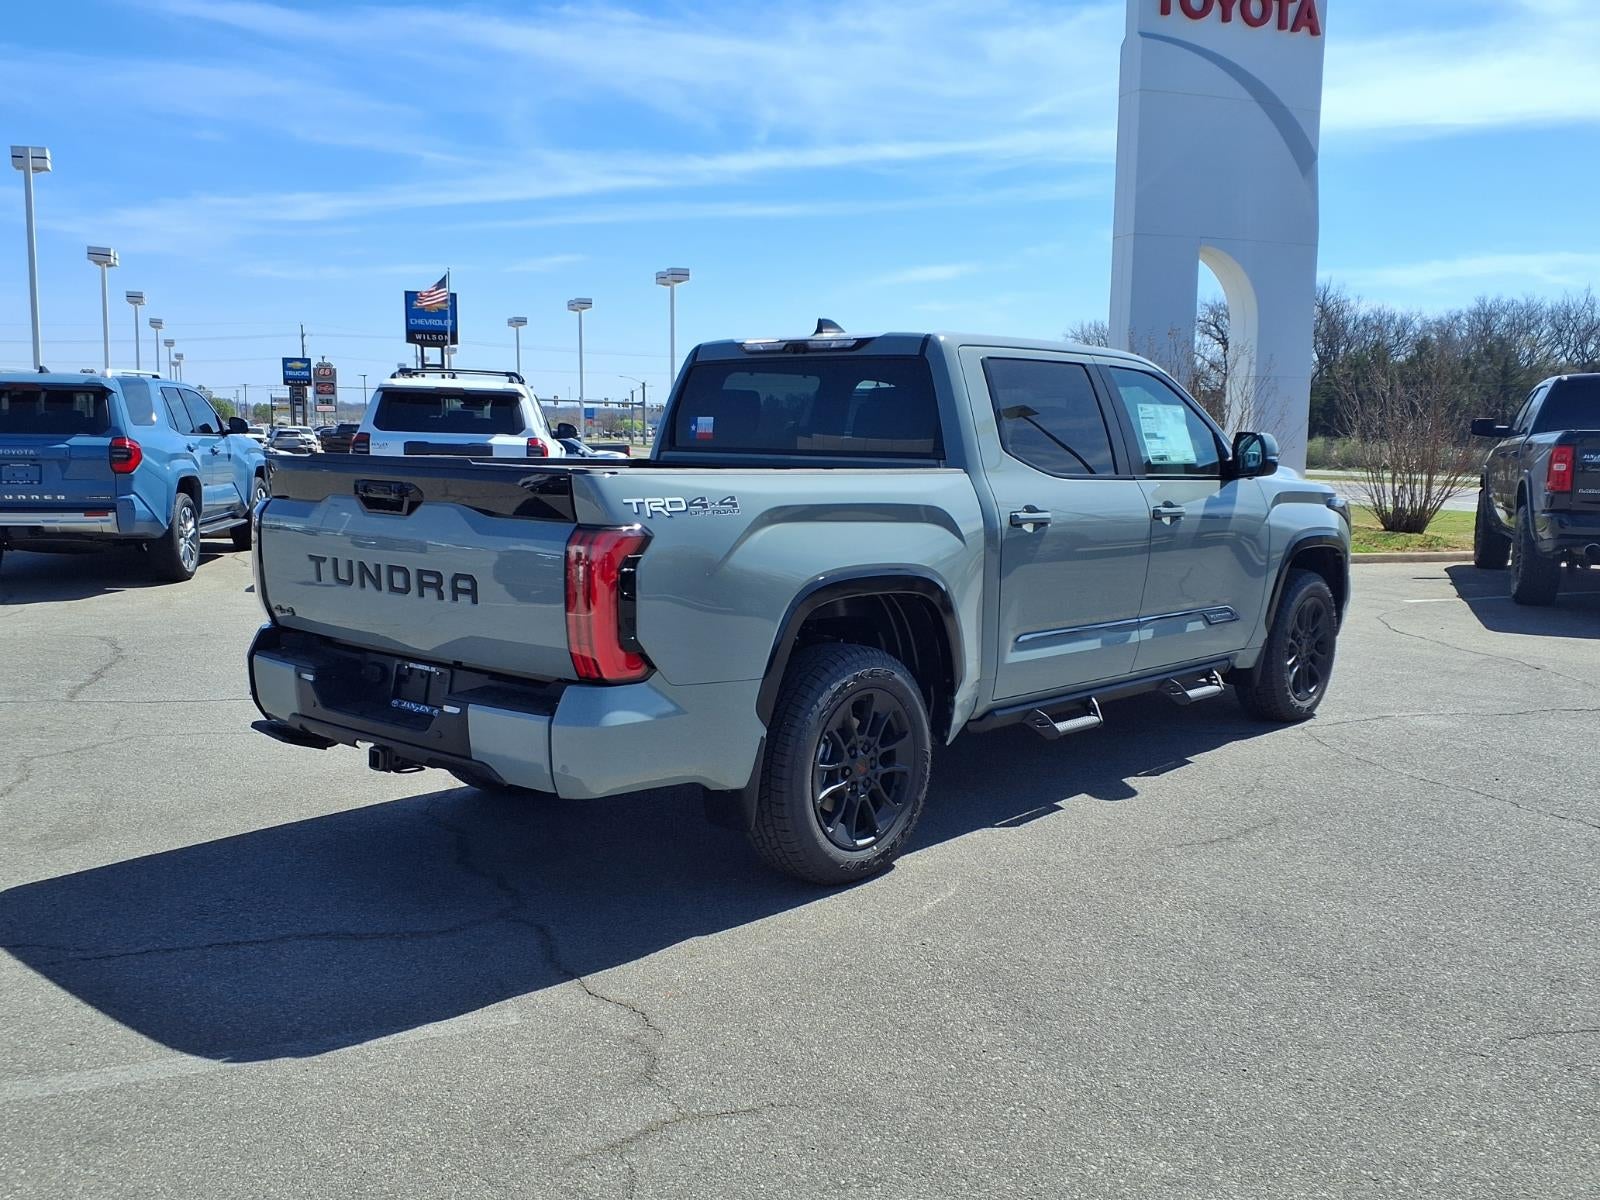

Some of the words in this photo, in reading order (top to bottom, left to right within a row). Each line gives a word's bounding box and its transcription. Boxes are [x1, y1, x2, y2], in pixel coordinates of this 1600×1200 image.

[410, 318, 453, 326] CHEVROLET
[415, 333, 450, 341] WILSON
[319, 368, 332, 376] 66
[622, 496, 688, 518] TRD
[307, 554, 478, 605] TUNDRA
